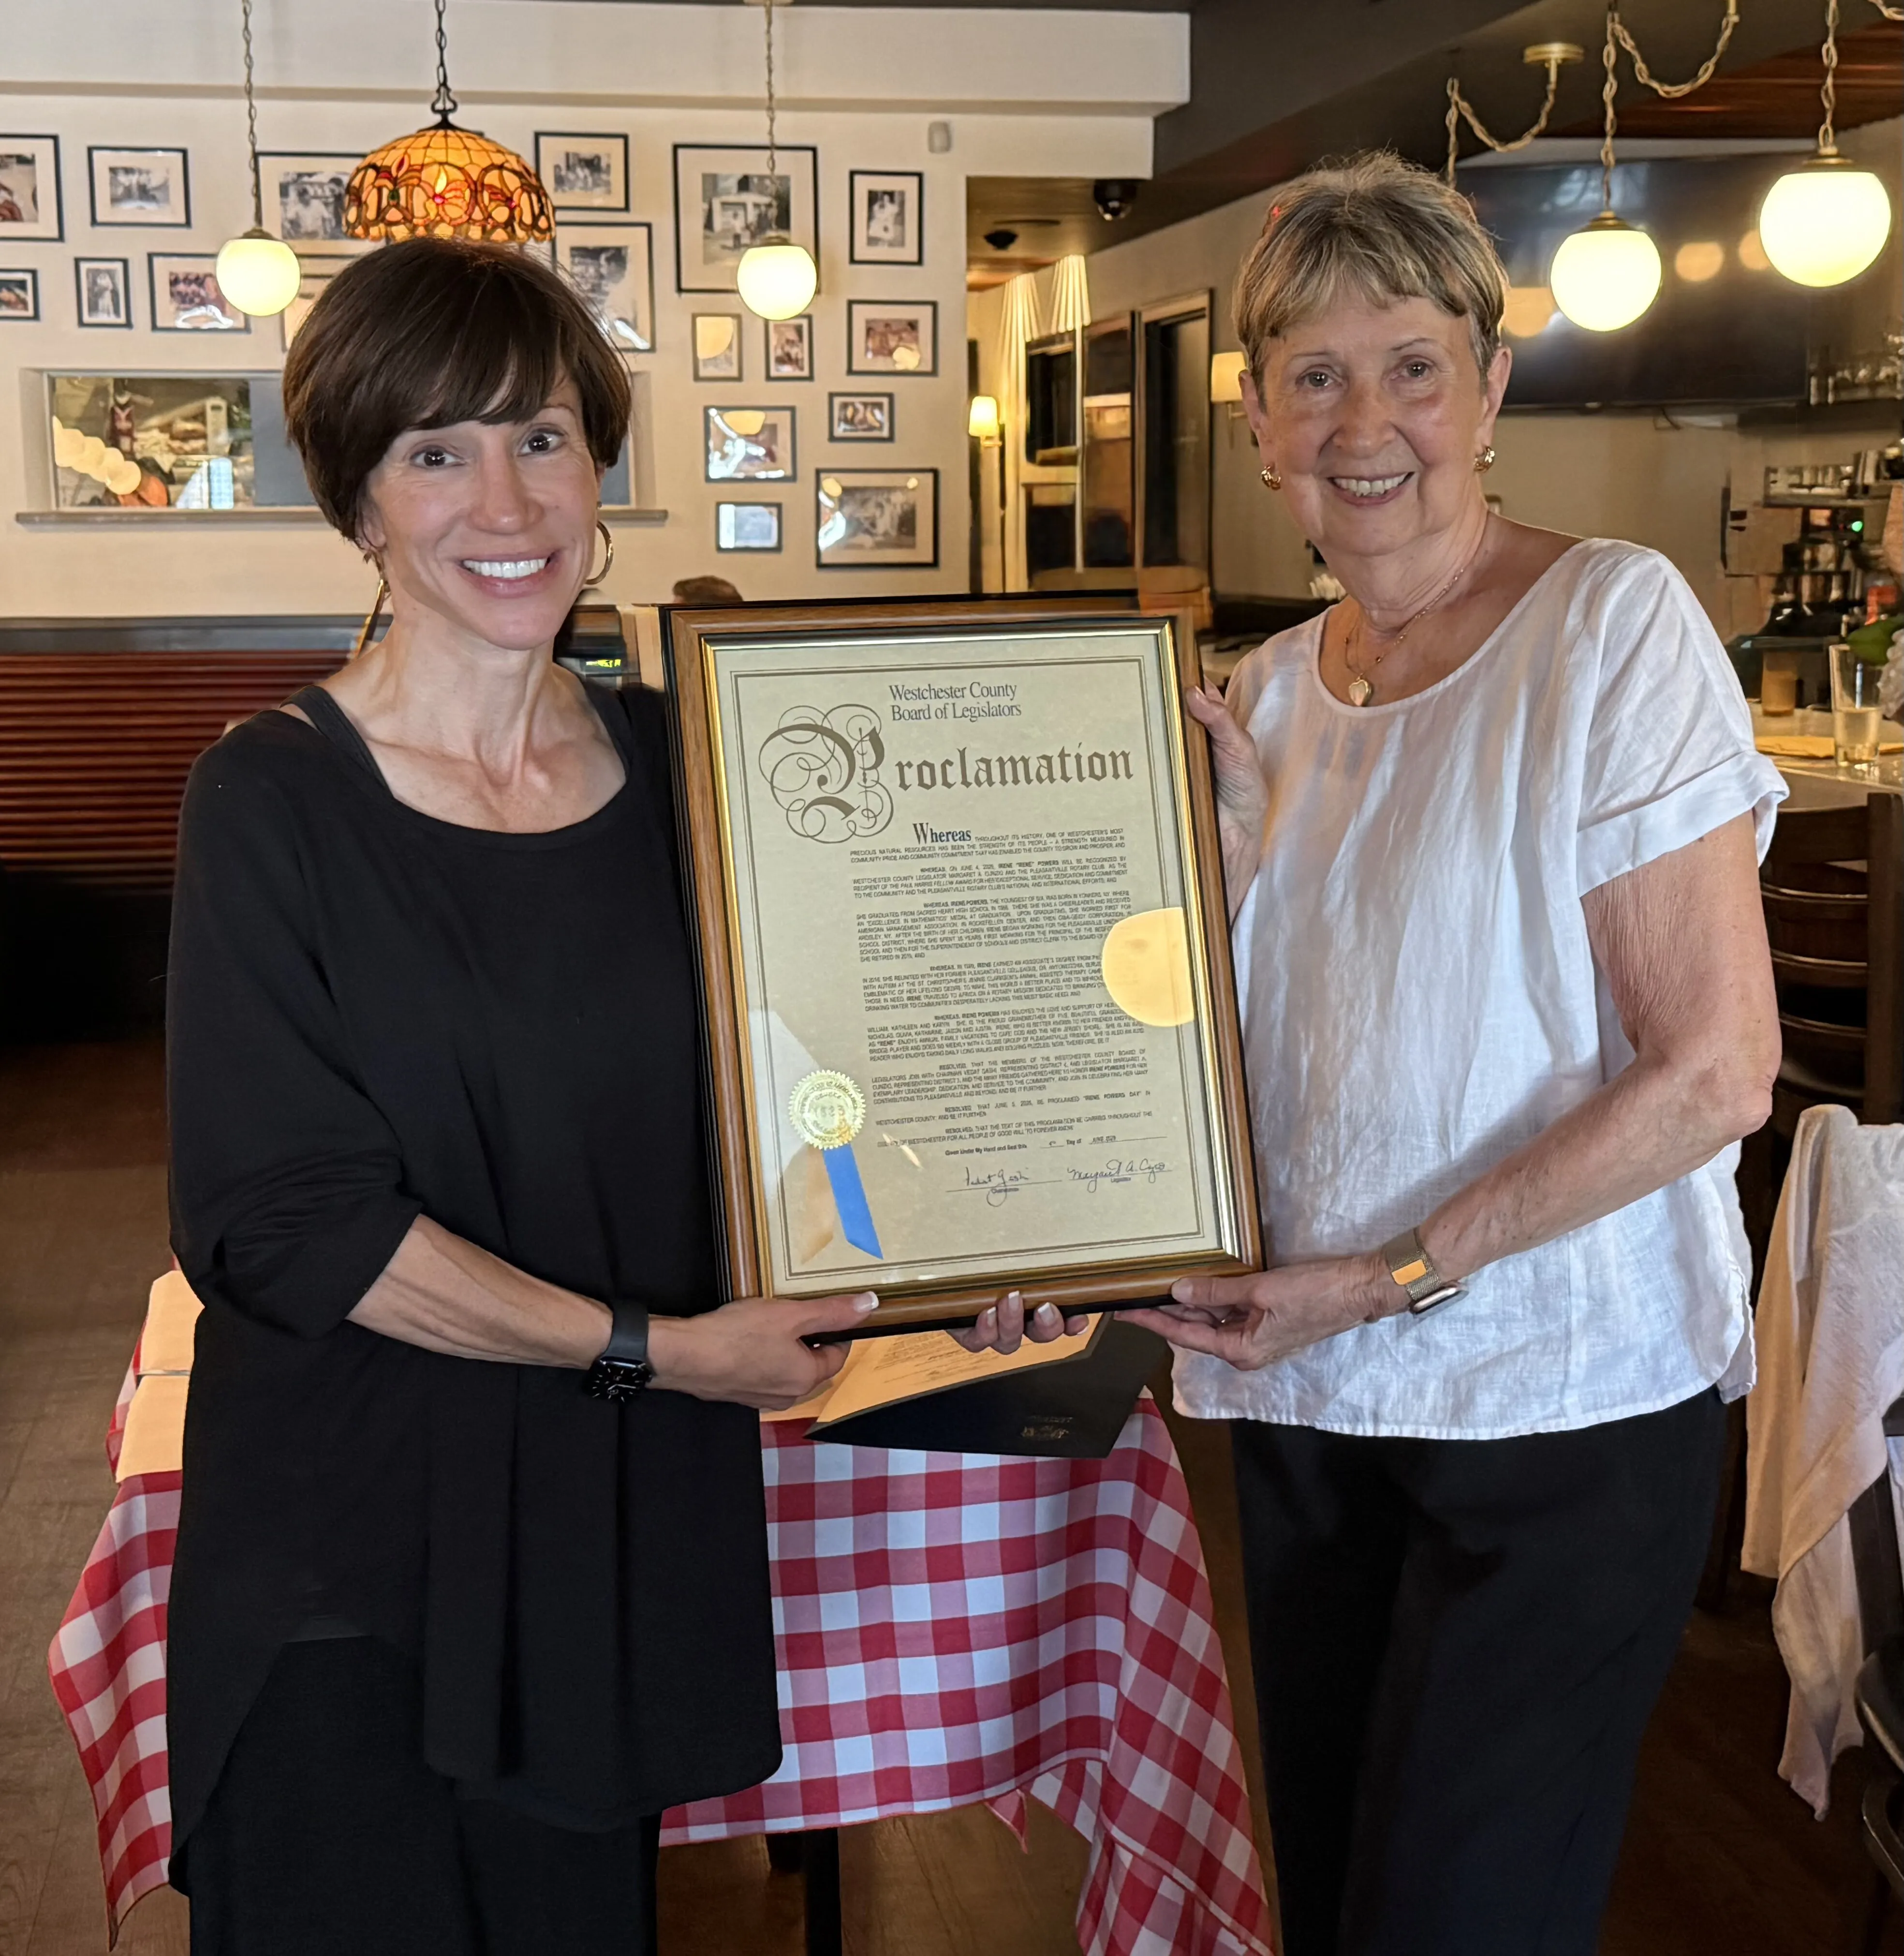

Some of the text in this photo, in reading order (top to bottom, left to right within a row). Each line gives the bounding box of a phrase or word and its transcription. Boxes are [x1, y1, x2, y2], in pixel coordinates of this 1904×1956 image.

[889, 681, 1017, 701] Westchester County
[891, 701, 1022, 722] Board of Legislators
[759, 704, 1134, 843] Proclamation
[913, 822, 971, 844] Whereas
